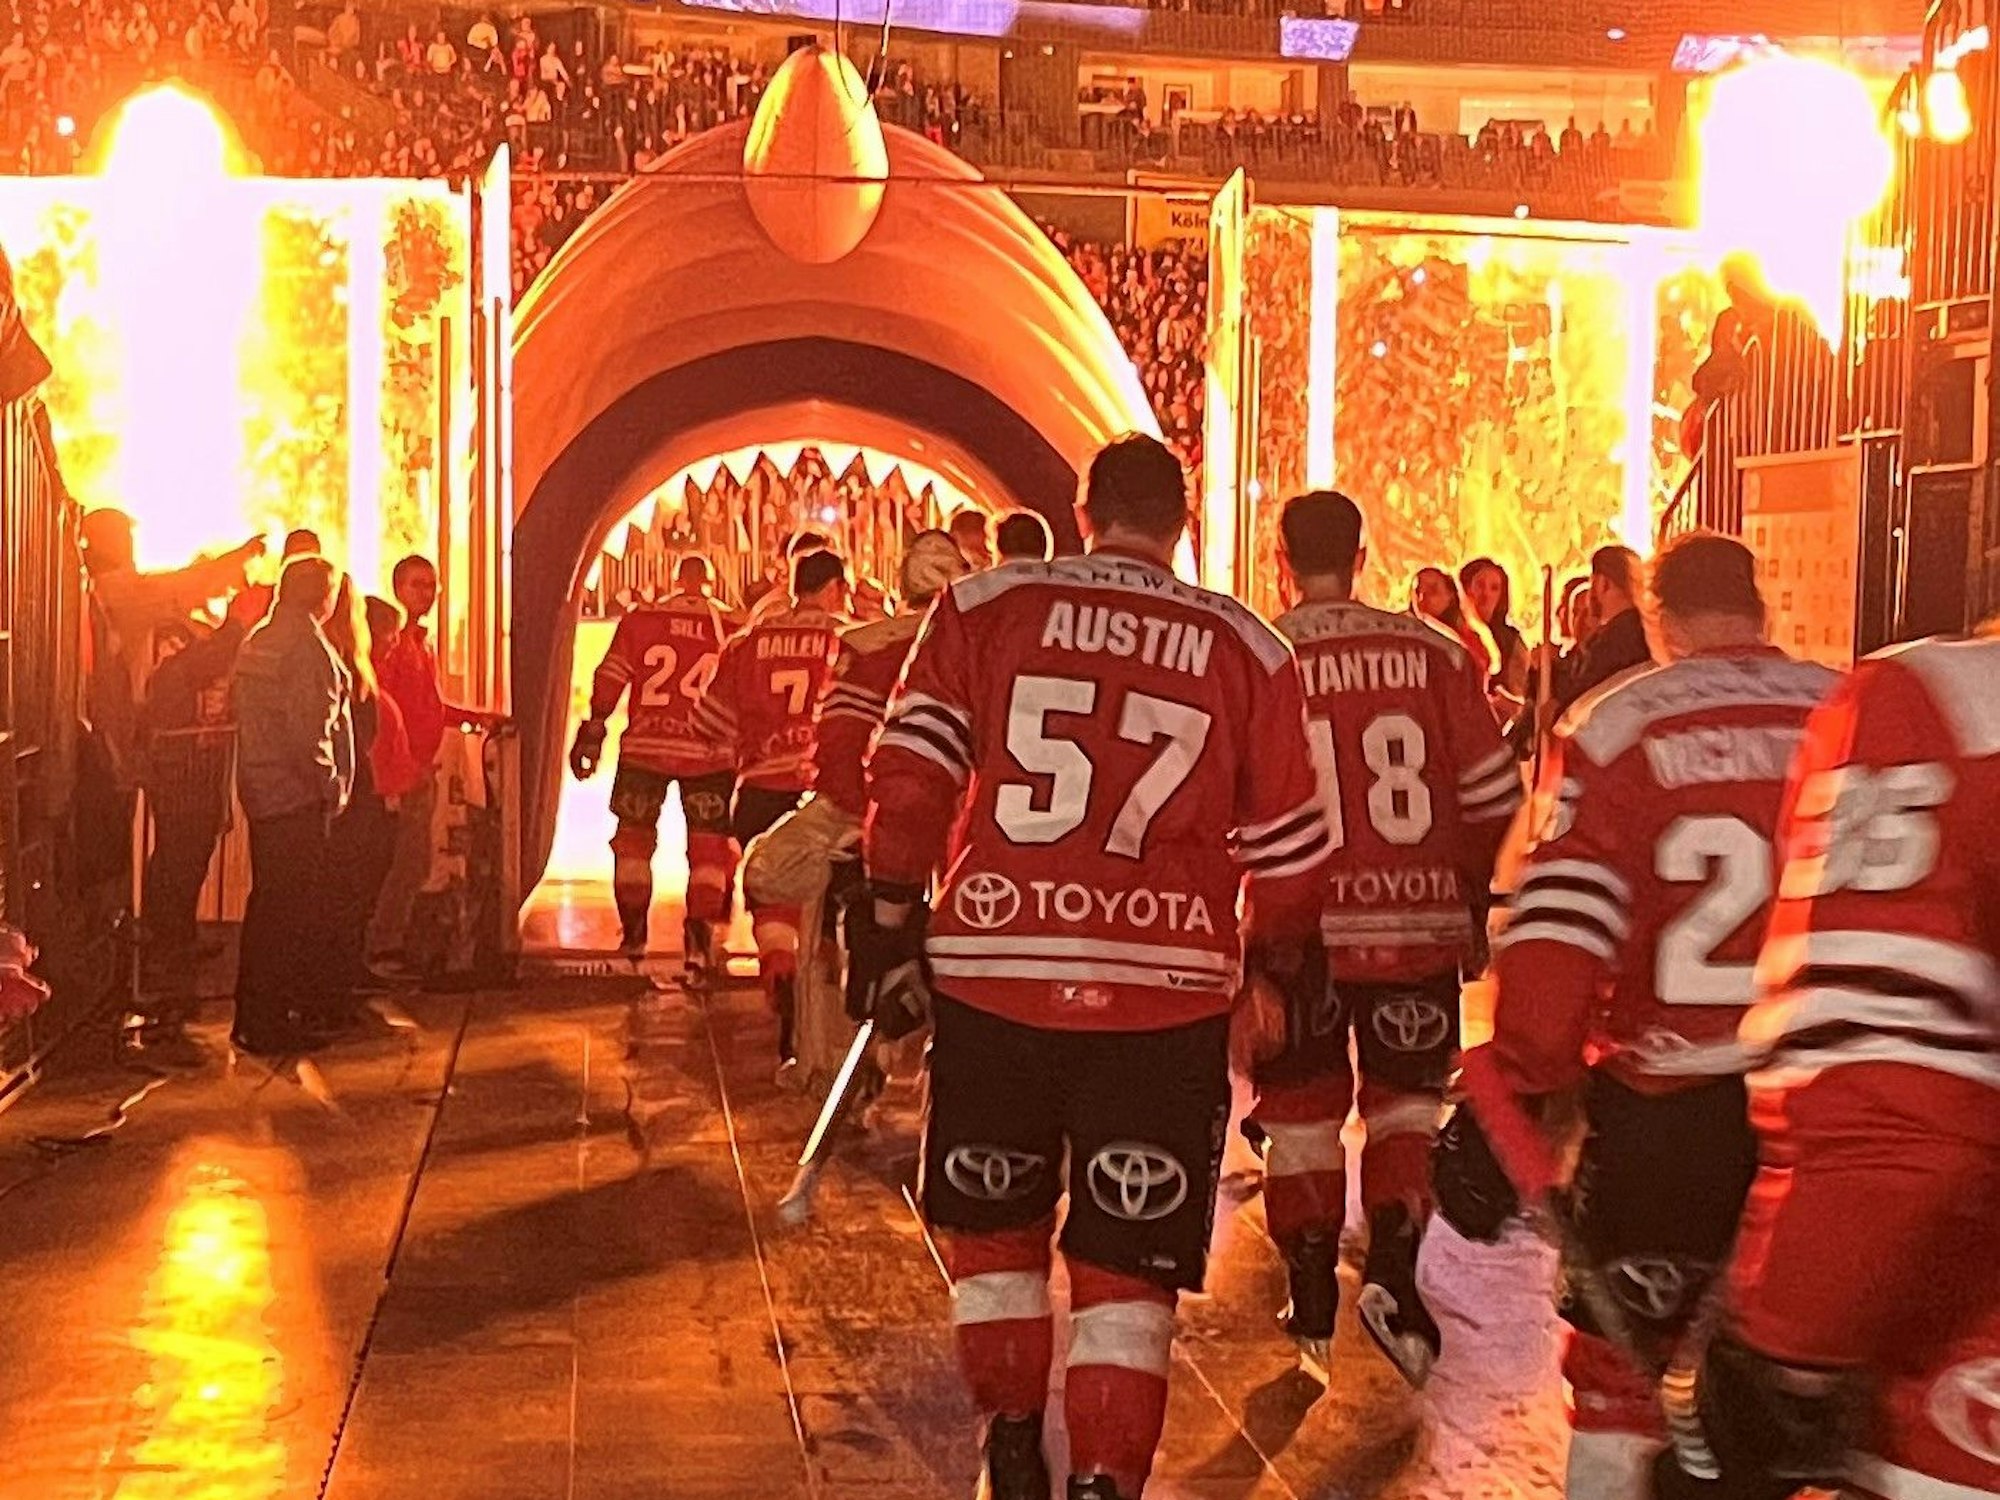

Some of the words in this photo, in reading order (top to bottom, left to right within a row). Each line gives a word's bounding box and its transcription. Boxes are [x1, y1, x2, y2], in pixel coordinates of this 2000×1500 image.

[1042, 601, 1214, 677] AUSTIN
[640, 644, 720, 709] 24
[770, 669, 810, 715] 7
[995, 675, 1212, 859] 57
[1308, 714, 1432, 848] 18
[1030, 880, 1214, 935] TOYOTA
[1330, 870, 1459, 903] TOYOTA
